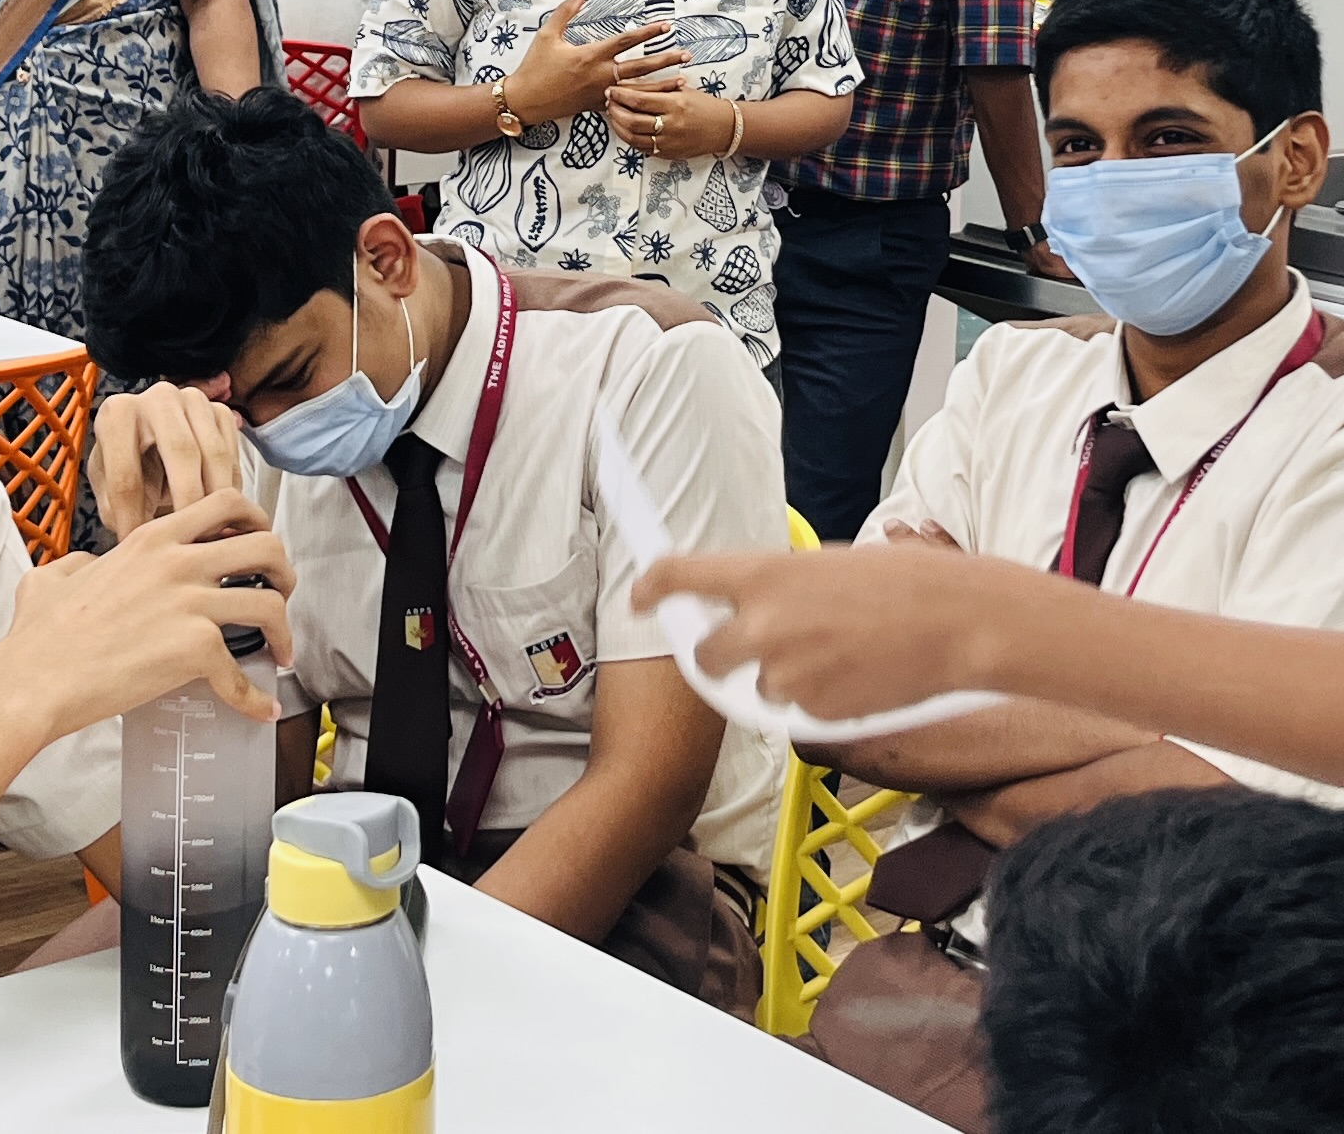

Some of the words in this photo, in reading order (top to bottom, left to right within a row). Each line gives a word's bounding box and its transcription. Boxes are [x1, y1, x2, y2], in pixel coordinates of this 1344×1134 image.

[487, 360, 503, 389] THE
[495, 310, 511, 359] ADITYA
[532, 634, 565, 654] ABPS
